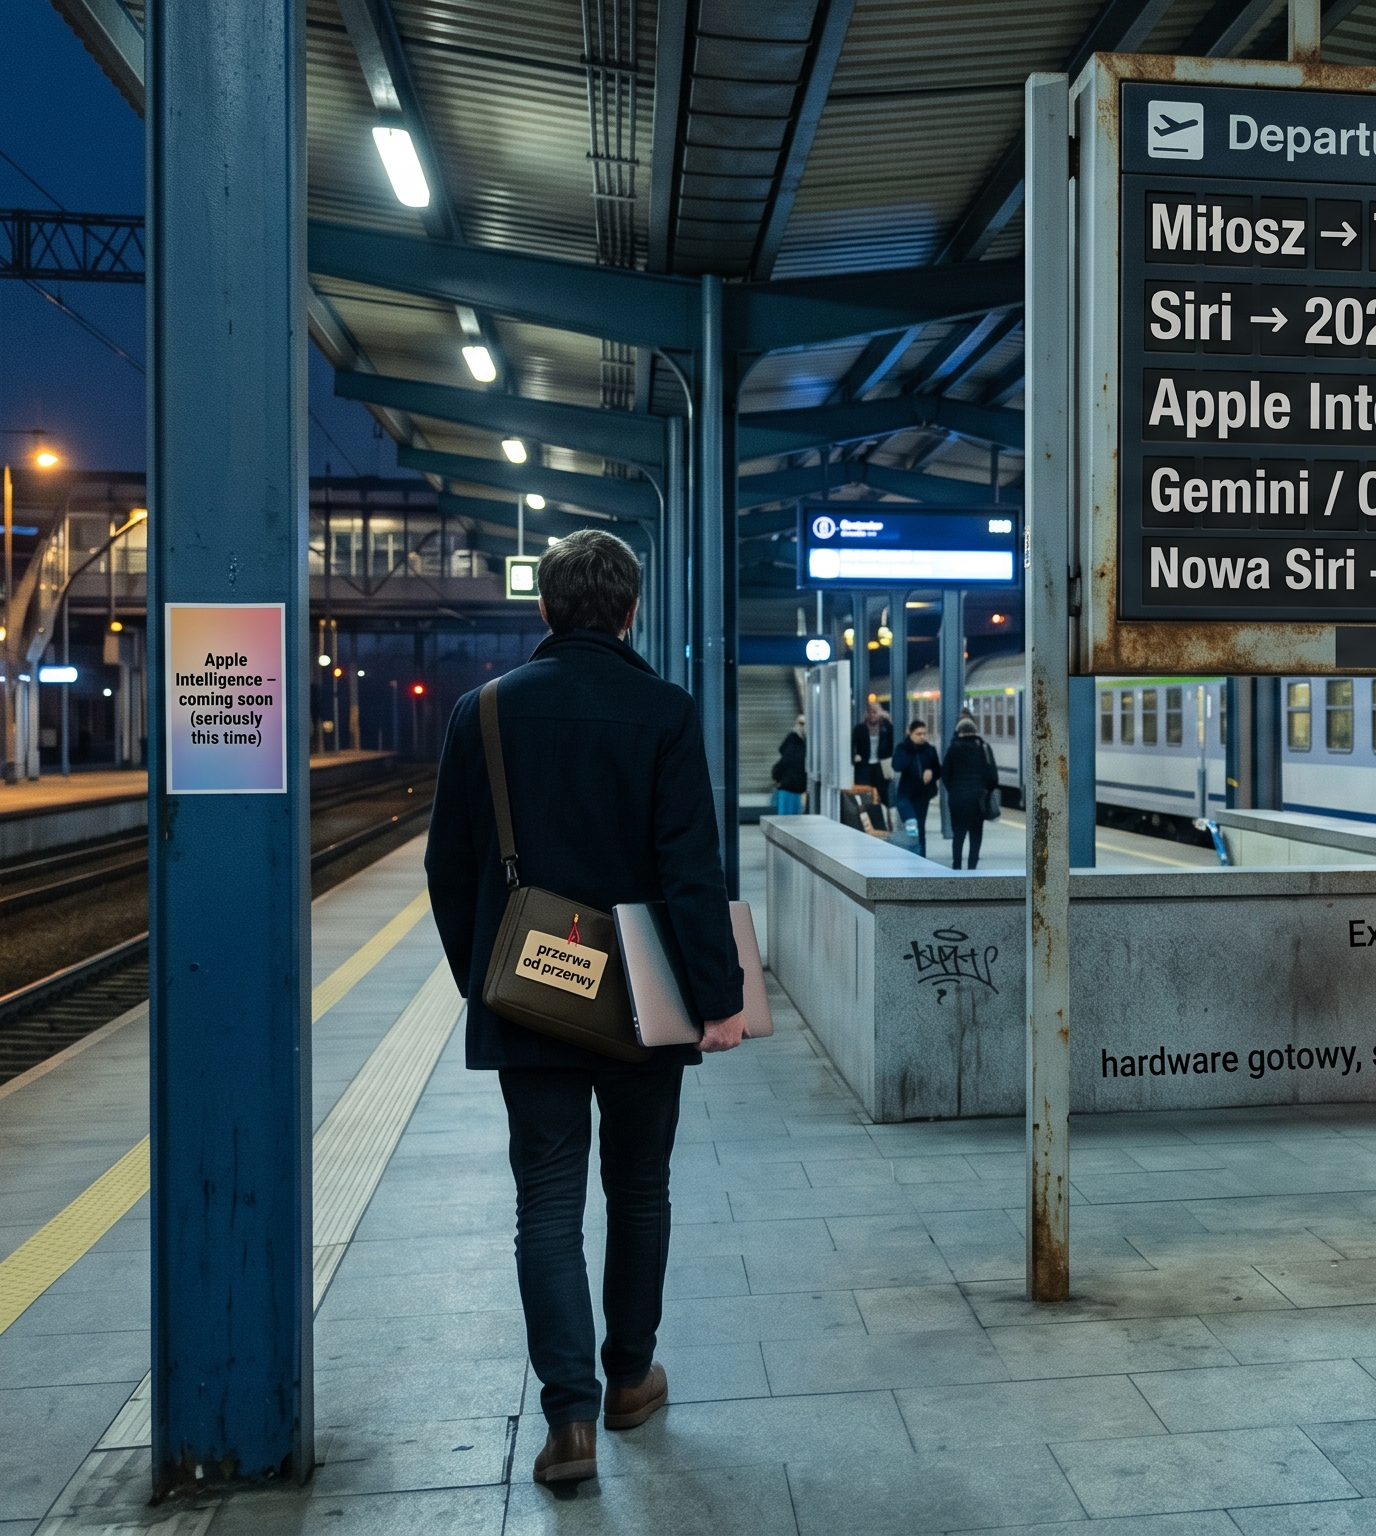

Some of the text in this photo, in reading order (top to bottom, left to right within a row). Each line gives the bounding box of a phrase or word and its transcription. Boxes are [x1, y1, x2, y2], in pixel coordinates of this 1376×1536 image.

[1152, 203, 1306, 256] Miłosz
[1150, 290, 1232, 341] Siri
[1148, 378, 1291, 439] Apple
[1150, 467, 1309, 515] Gemini
[1323, 470, 1345, 516] /
[1150, 546, 1270, 590] Nowa
[1285, 547, 1355, 590] Siri
[204, 652, 248, 670] Apple
[175, 671, 263, 690] Intelligence
[178, 691, 273, 710] coming soon
[190, 710, 263, 729] (seriously
[190, 729, 262, 748] this time)
[536, 944, 591, 969] przerwa
[523, 957, 595, 990] od przerwy
[1101, 1045, 1239, 1078] hardware
[1247, 1043, 1362, 1080] gotowy,
